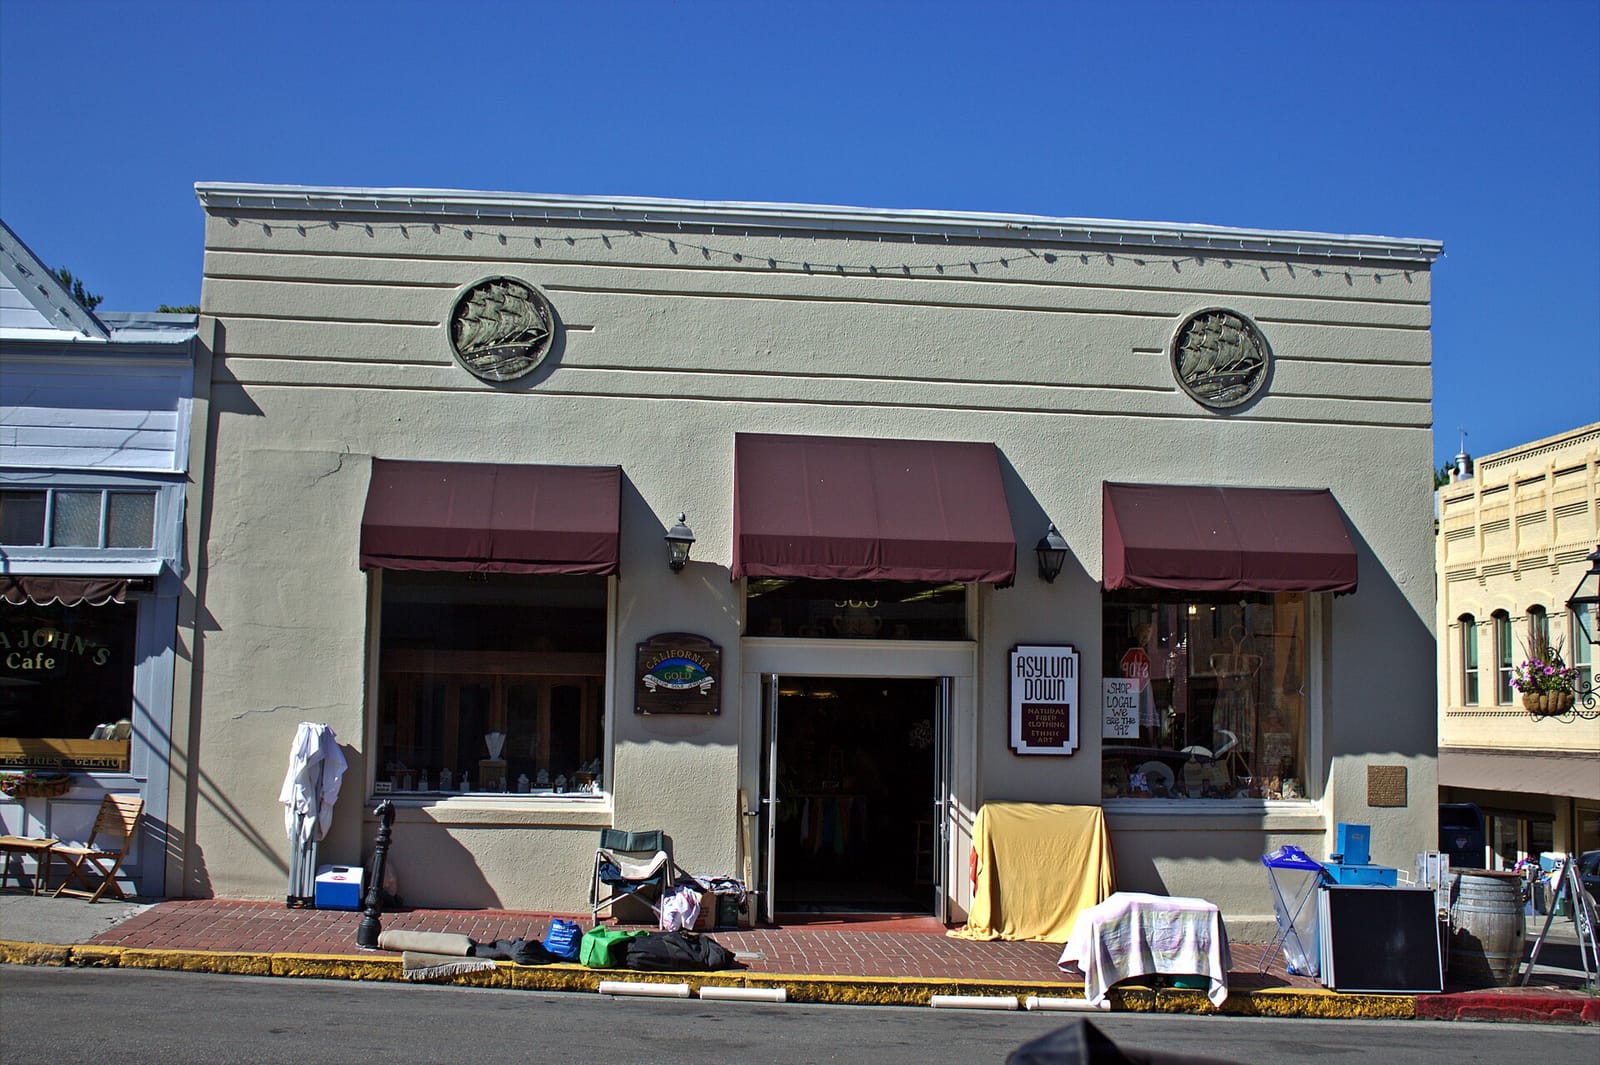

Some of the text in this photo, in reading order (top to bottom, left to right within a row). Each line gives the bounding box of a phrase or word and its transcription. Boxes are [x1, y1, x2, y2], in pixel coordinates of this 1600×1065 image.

[17, 627, 112, 666] JOHN'S
[5, 651, 57, 670] Cafe
[646, 649, 711, 671] CALIFORNIA
[1016, 656, 1073, 678] ASYLUM
[664, 671, 692, 681] GOLD
[1024, 678, 1065, 701] DOWN
[1107, 682, 1132, 694] SHOP
[1027, 707, 1065, 715] NATURAL
[1106, 697, 1136, 708] LOCAL
